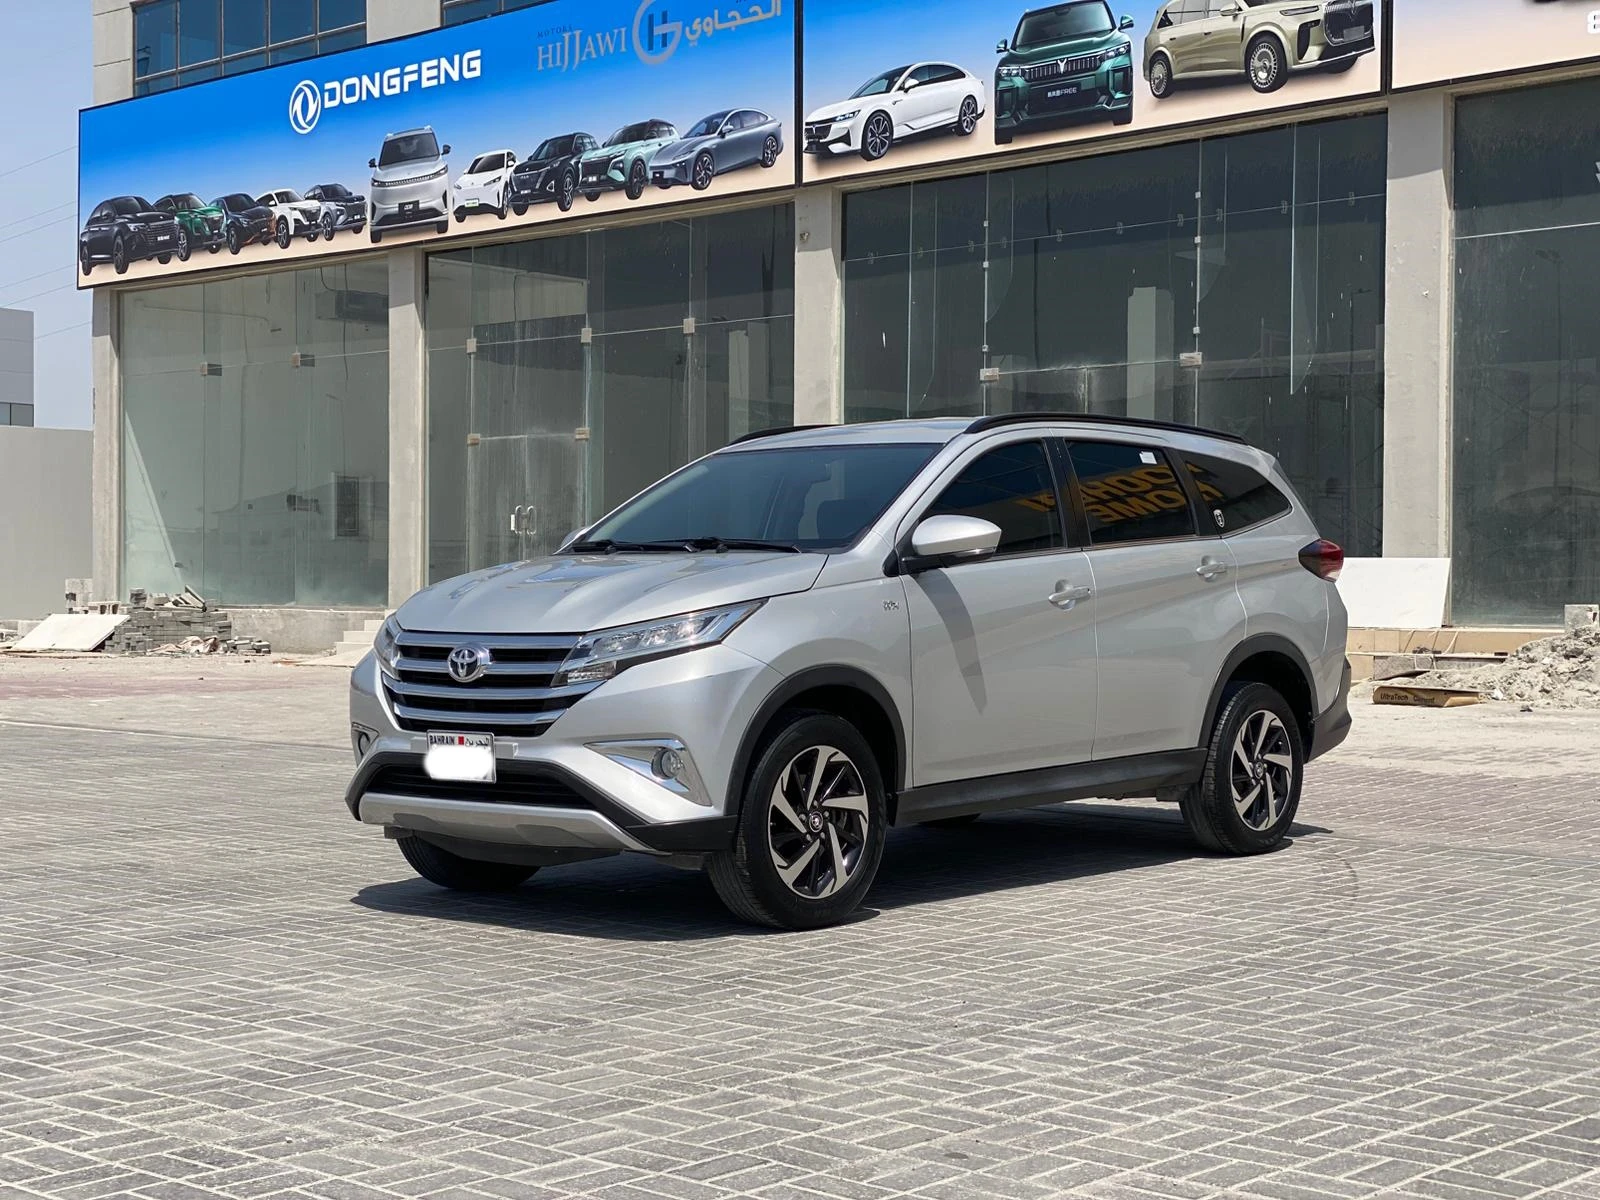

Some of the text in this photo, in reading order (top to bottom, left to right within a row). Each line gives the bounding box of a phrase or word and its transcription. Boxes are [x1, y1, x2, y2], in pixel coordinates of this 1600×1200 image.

[537, 27, 627, 72] HIJJAWI
[323, 49, 482, 109] DONGFENG
[429, 735, 455, 745] BAHRAIN
